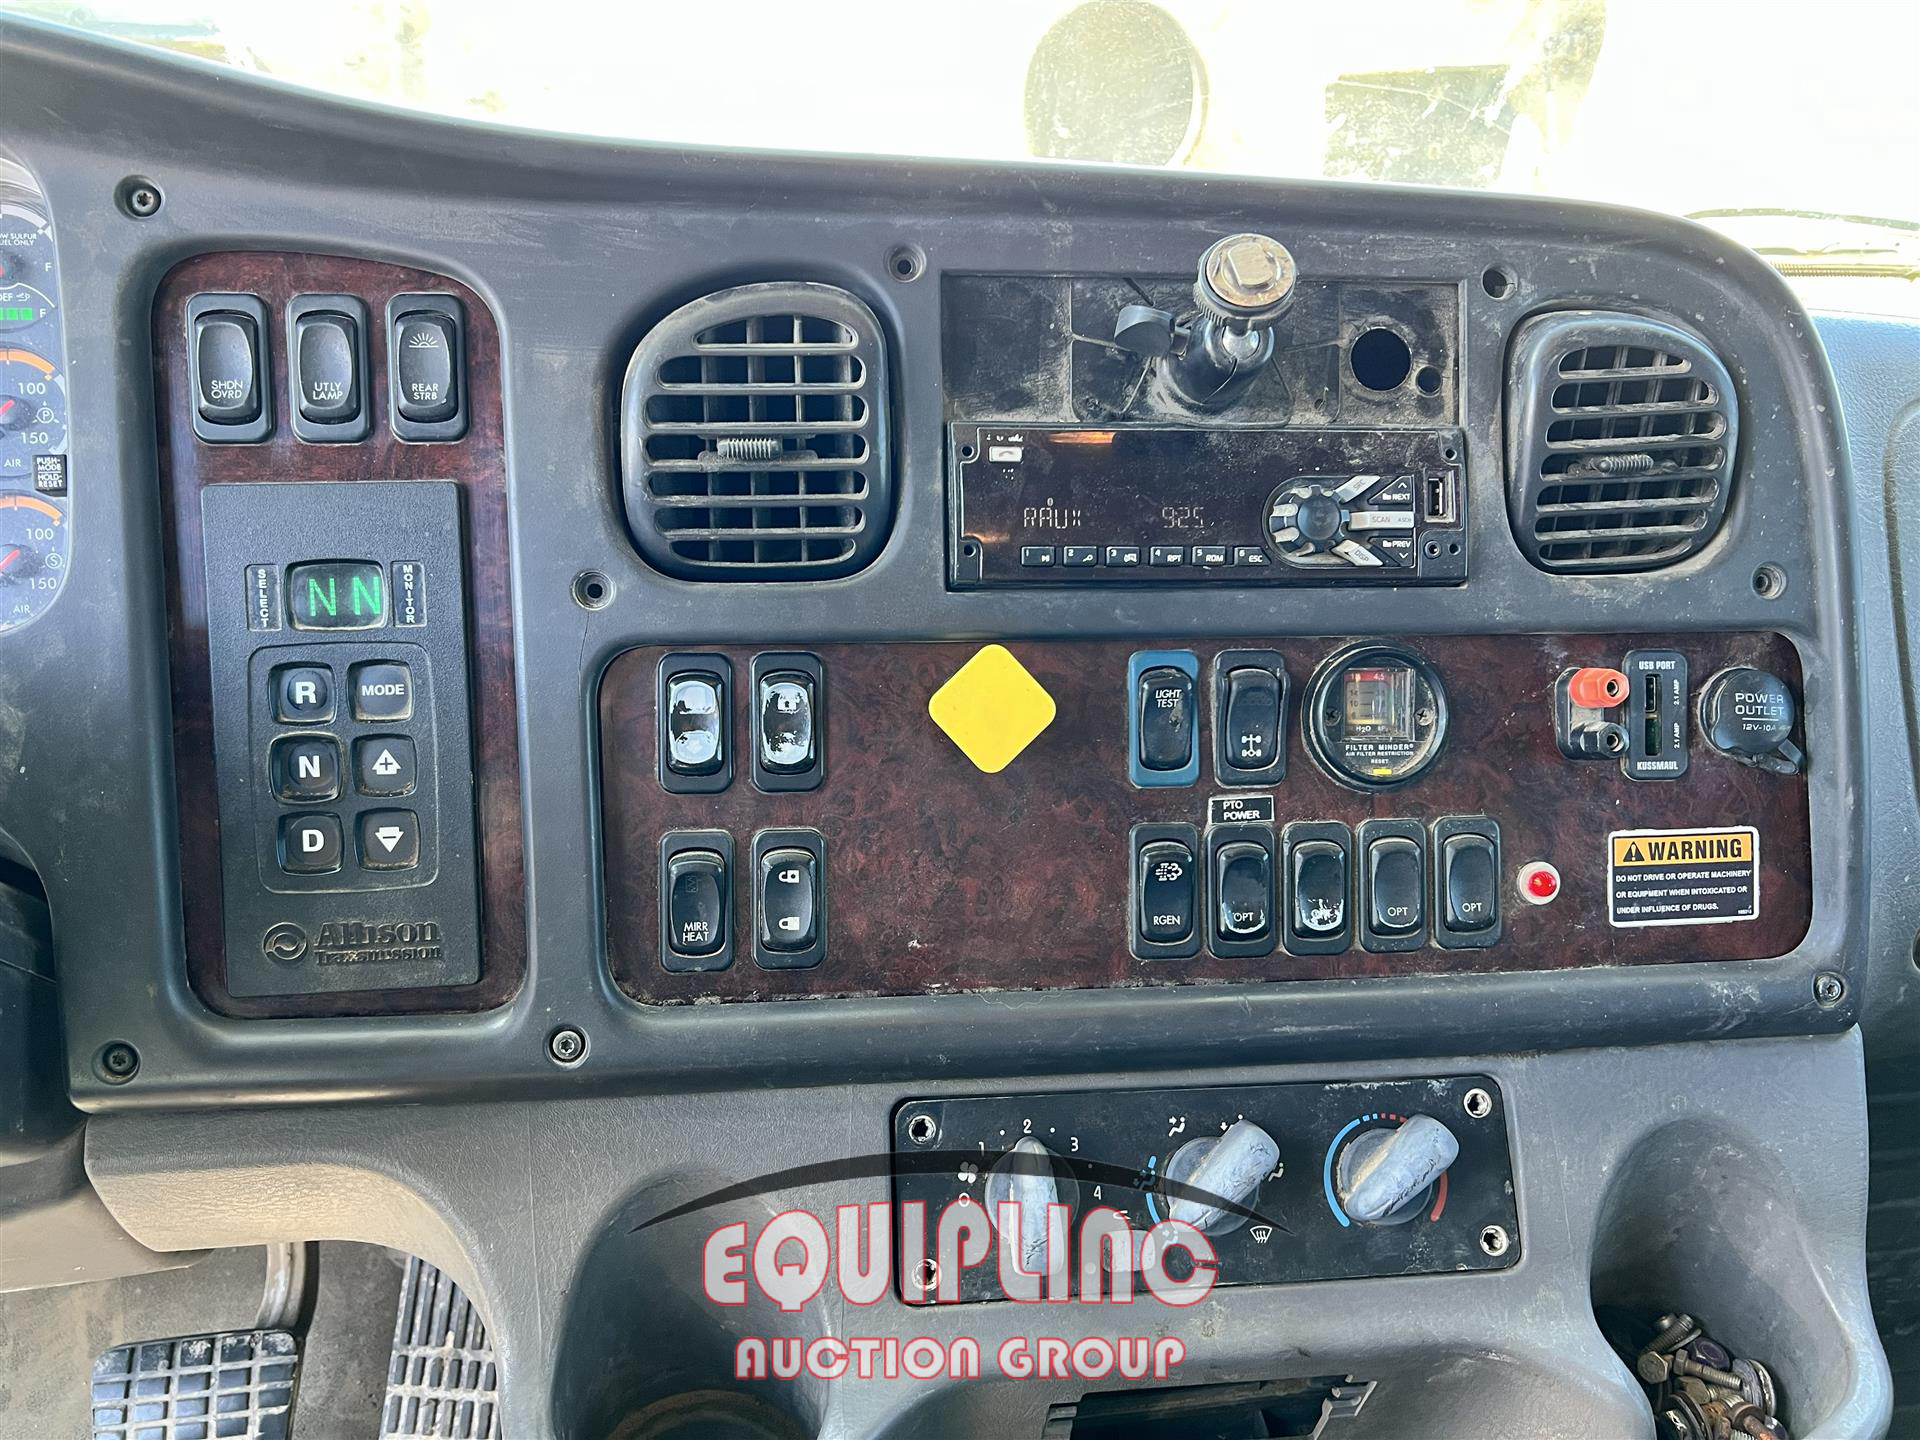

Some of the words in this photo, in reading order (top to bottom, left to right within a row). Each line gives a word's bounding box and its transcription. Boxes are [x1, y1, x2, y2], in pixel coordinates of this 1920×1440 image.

[10, 232, 37, 240] SULFUR
[45, 262, 53, 272] F
[39, 308, 47, 318] F
[18, 382, 46, 395] 100
[211, 379, 243, 390] SHDN
[314, 382, 342, 391] UTLY
[411, 383, 439, 393] REAR
[211, 389, 243, 400] OVRD
[312, 390, 343, 401] LAMP
[413, 391, 438, 401] STRB
[21, 432, 49, 445] 150
[3, 458, 22, 468] AIR
[37, 464, 62, 472] MODE
[38, 480, 63, 488] RESET
[1371, 515, 1391, 523] SCAN
[26, 527, 54, 541] 100
[1392, 540, 1412, 548] PREV
[1067, 548, 1075, 557] 2
[1154, 549, 1161, 557] 4
[1166, 554, 1181, 562] RPT
[1196, 549, 1203, 557] 5
[1248, 555, 1263, 563] ESC
[30, 577, 57, 590] 150
[257, 568, 269, 628] SELECT
[402, 564, 416, 624] MONITOR
[13, 604, 31, 614] AIR
[1638, 660, 1654, 670] USB
[1656, 660, 1676, 670] PORT
[295, 681, 317, 704] R
[361, 684, 405, 696] MODE
[1155, 689, 1182, 699] LIGHT
[1157, 698, 1178, 708] TEST
[1735, 692, 1784, 704] POWER
[1735, 705, 1784, 716] OUTLET
[298, 755, 321, 778] N
[1637, 761, 1679, 771] KUSSMAUL
[1223, 801, 1244, 811] PTO
[1223, 809, 1261, 821] POWER
[302, 829, 325, 852] D
[1648, 838, 1743, 862] WARNING
[1615, 875, 1627, 883] DO
[1627, 874, 1642, 882] NOT
[1643, 873, 1665, 881] DRIVE
[1666, 872, 1677, 880] OR
[1678, 871, 1710, 879] OPERATE
[1711, 869, 1752, 879] MACHINERY
[1627, 890, 1668, 899] EQUIPMENT
[1669, 889, 1690, 897] WHEN
[1691, 887, 1736, 896] INTOXICATED
[1737, 886, 1748, 894] OR
[1387, 906, 1409, 917] OPT
[1461, 901, 1483, 913] OPT
[1616, 905, 1640, 915] UNDER
[1641, 904, 1680, 914] INFLUENCE
[1681, 904, 1691, 912] OF
[1692, 903, 1719, 911] DRUGS.
[1152, 914, 1181, 926] RGEN
[1234, 911, 1254, 922] OPT
[684, 922, 709, 931] MIRR
[683, 931, 709, 942] HEAT
[1023, 1118, 1033, 1135] 2
[1070, 1136, 1080, 1153] 3
[1093, 1185, 1103, 1201] 4
